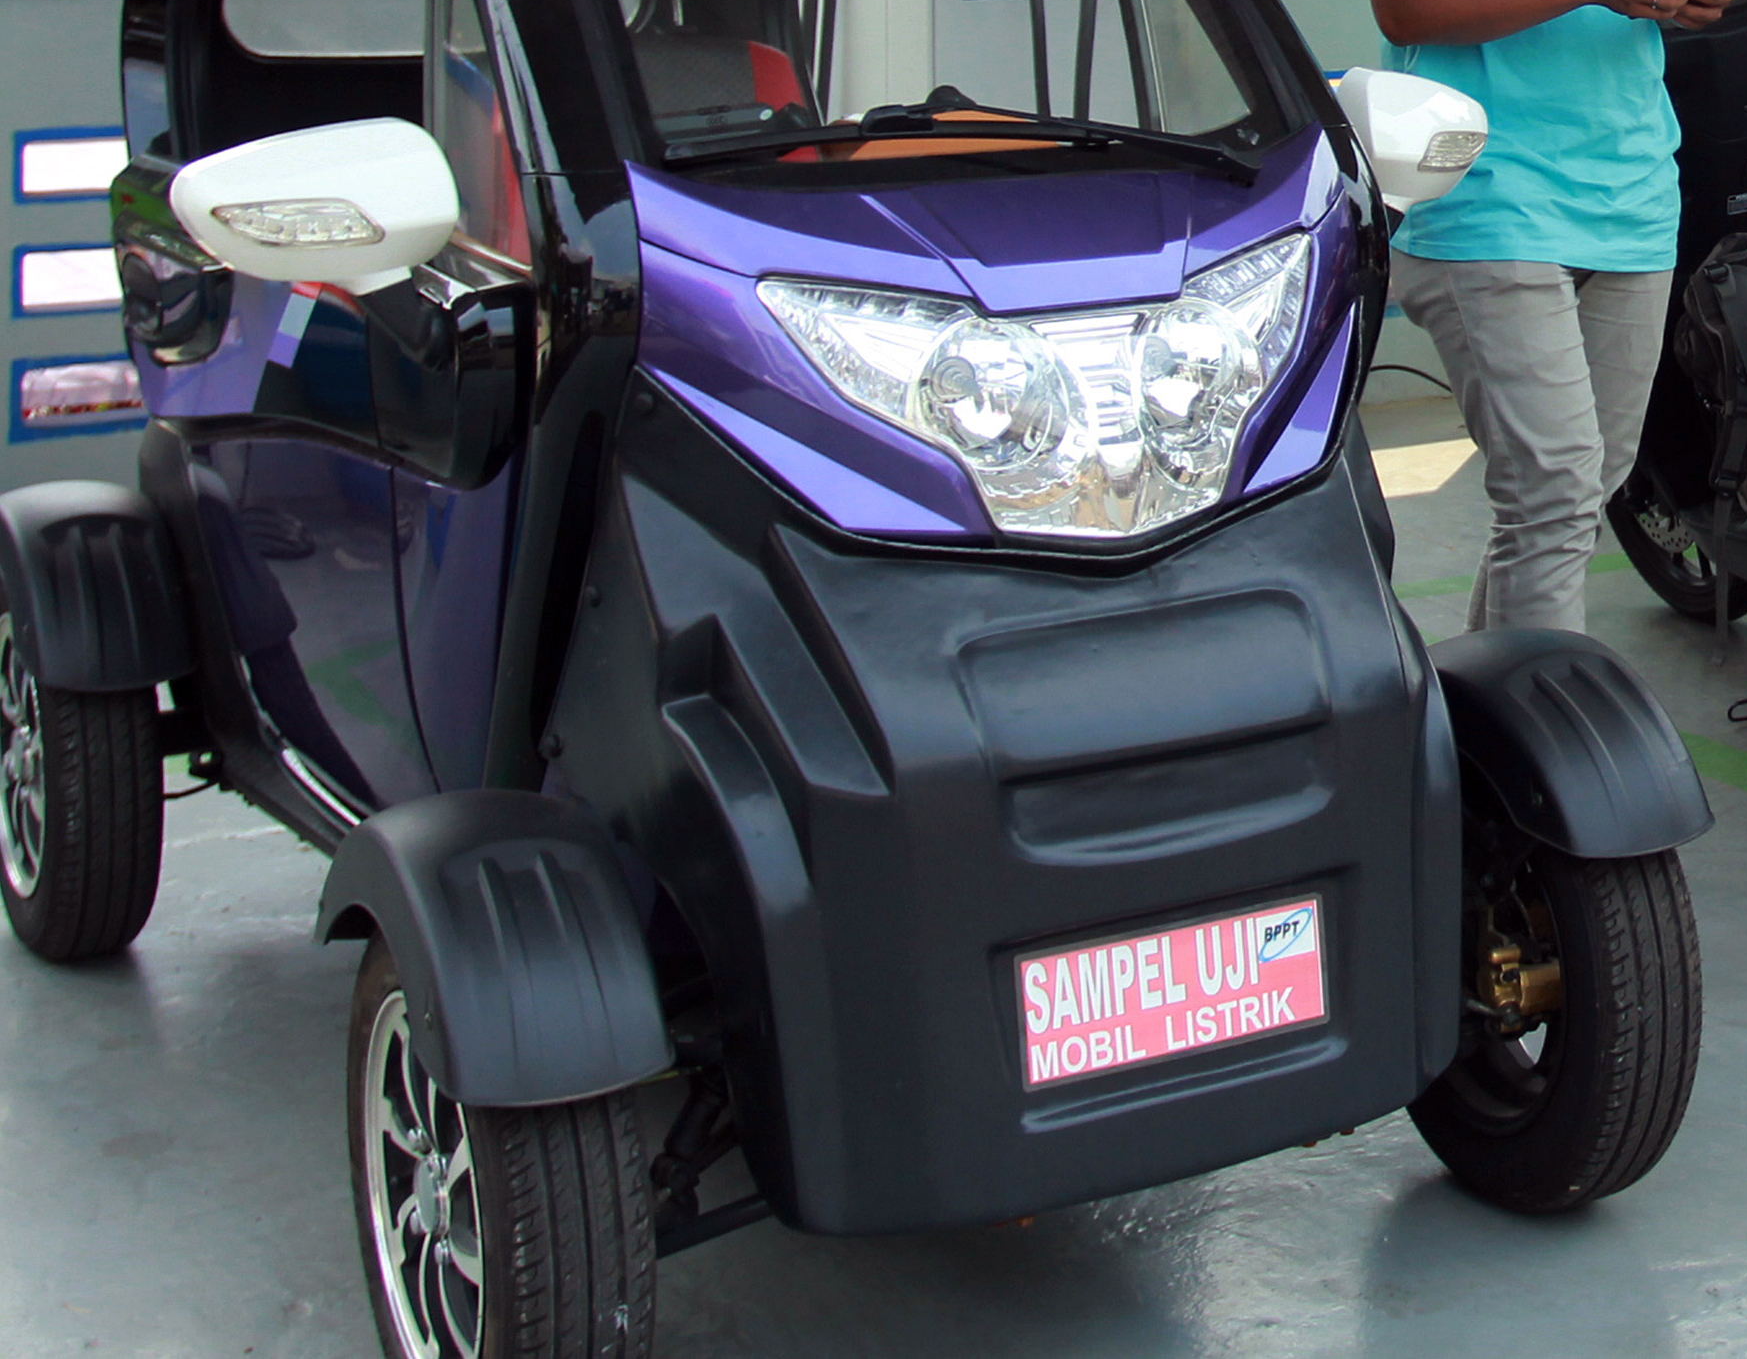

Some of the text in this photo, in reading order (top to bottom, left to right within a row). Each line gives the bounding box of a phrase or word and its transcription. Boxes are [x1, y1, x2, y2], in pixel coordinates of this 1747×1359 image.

[1024, 916, 1260, 1034] SAMPEL UJI
[1264, 920, 1300, 942] BPPT
[1030, 986, 1296, 1081] MOBIL LISTRIK
